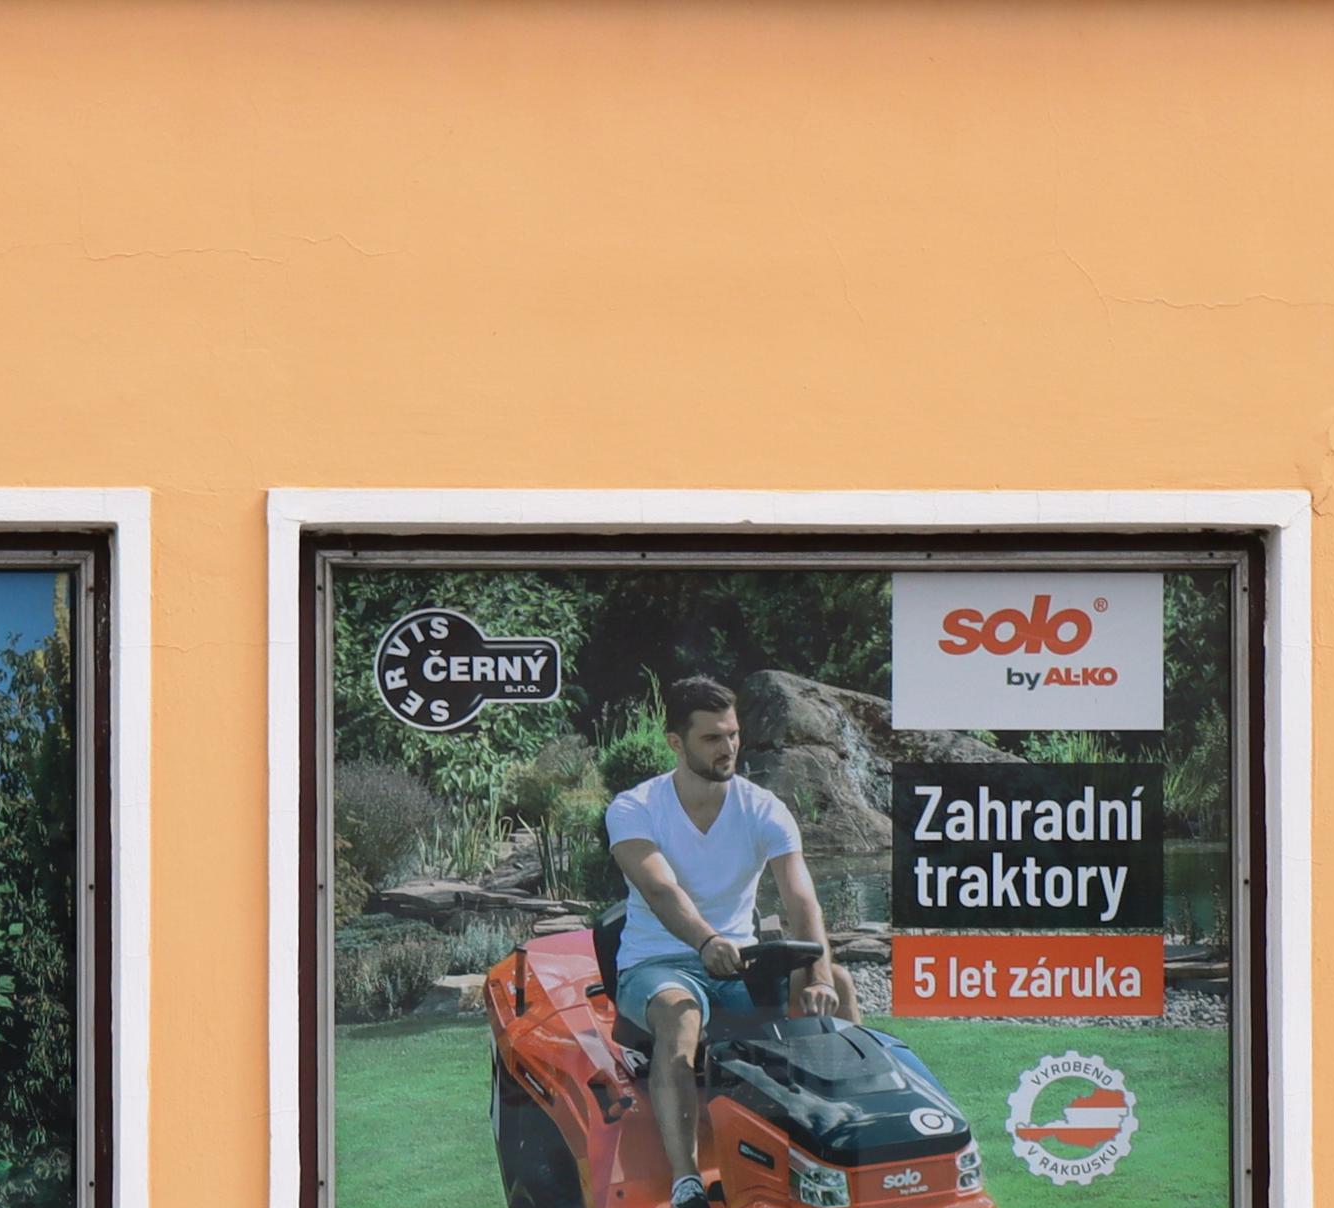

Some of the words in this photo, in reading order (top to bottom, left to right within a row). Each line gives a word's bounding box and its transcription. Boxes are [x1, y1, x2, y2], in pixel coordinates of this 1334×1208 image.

[938, 594, 1093, 656] solo
[385, 616, 450, 723] SERVIS
[422, 649, 549, 683] ČERNÝ
[1006, 667, 1042, 690] by
[1043, 667, 1118, 687] AL-KO
[504, 684, 541, 694] s.r.o.
[914, 785, 1145, 842] Zahradní
[913, 852, 1129, 922] traktory
[913, 956, 937, 999] 5
[949, 956, 998, 999] let
[1009, 956, 1142, 999] záruka
[1030, 1060, 1113, 1087] VYROBENO
[1027, 1145, 1039, 1157] V
[1038, 1144, 1118, 1176] RAKOUSKU
